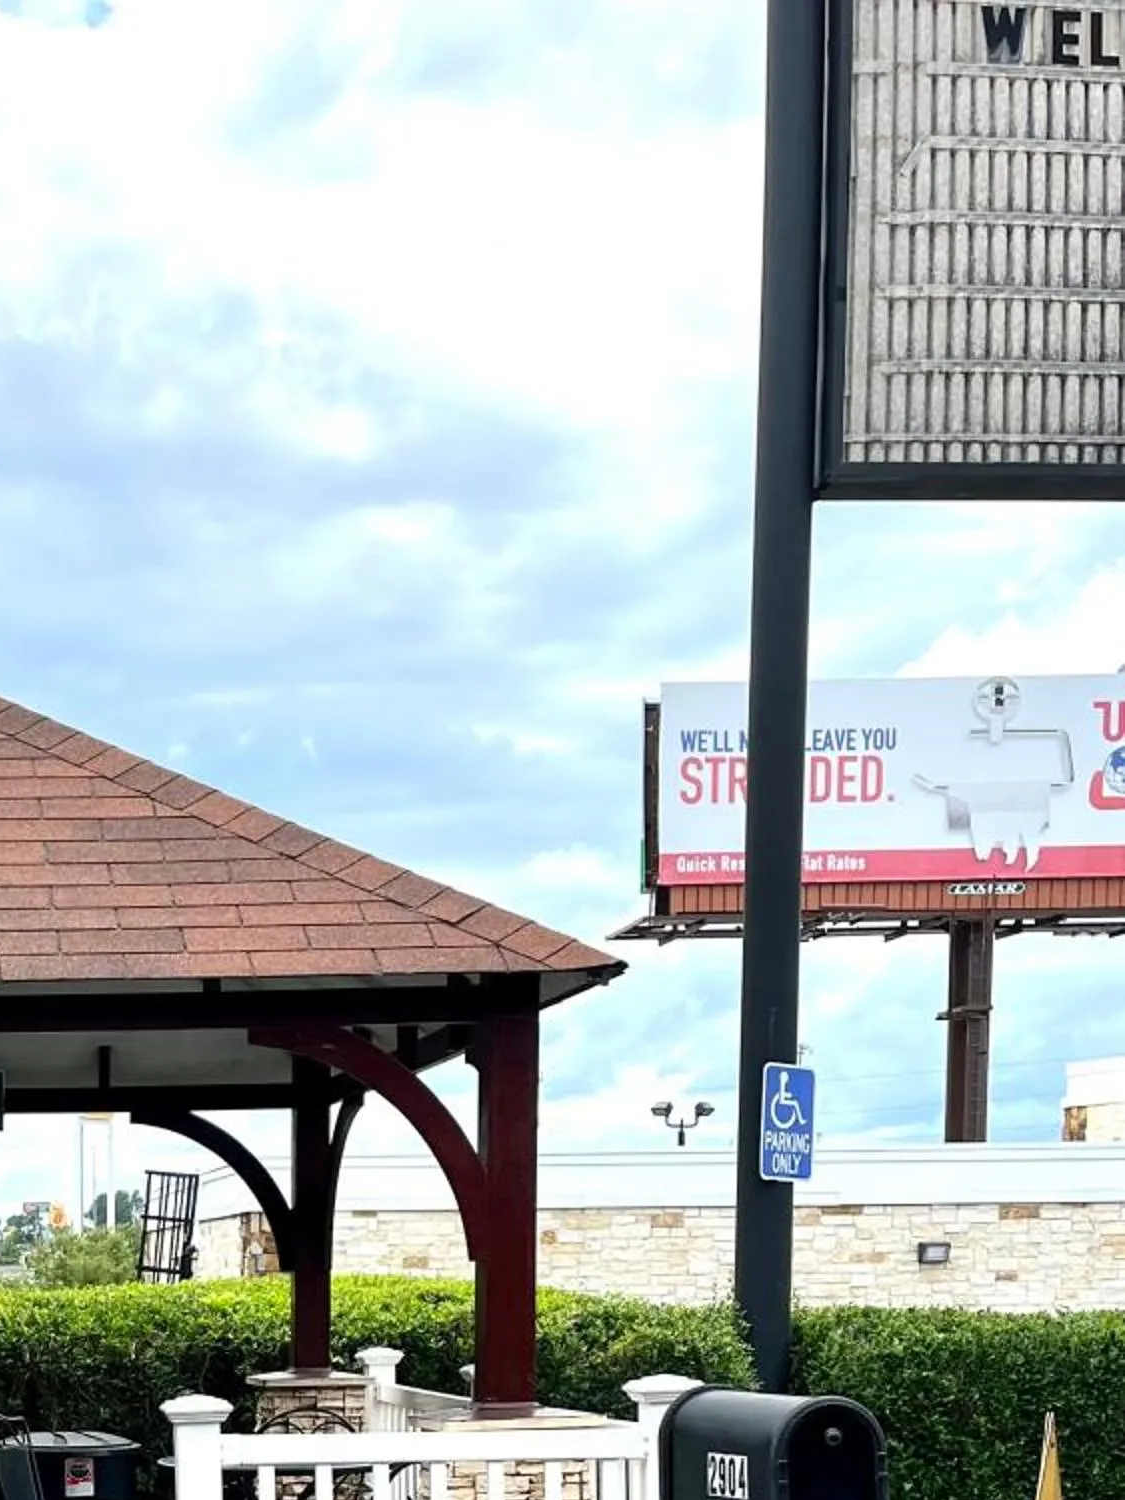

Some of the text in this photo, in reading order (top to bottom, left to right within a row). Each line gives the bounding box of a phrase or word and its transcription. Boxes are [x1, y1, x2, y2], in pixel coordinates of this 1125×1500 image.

[980, 5, 1120, 66] WEL
[680, 729, 734, 752] WE'LL
[861, 727, 897, 751] YOU
[679, 755, 894, 805] STRDED.
[676, 855, 716, 873] Quick
[827, 854, 866, 871] Rates
[764, 1130, 810, 1153] PARKING
[772, 1152, 802, 1174] ONLY
[708, 1455, 747, 1497] 2904
